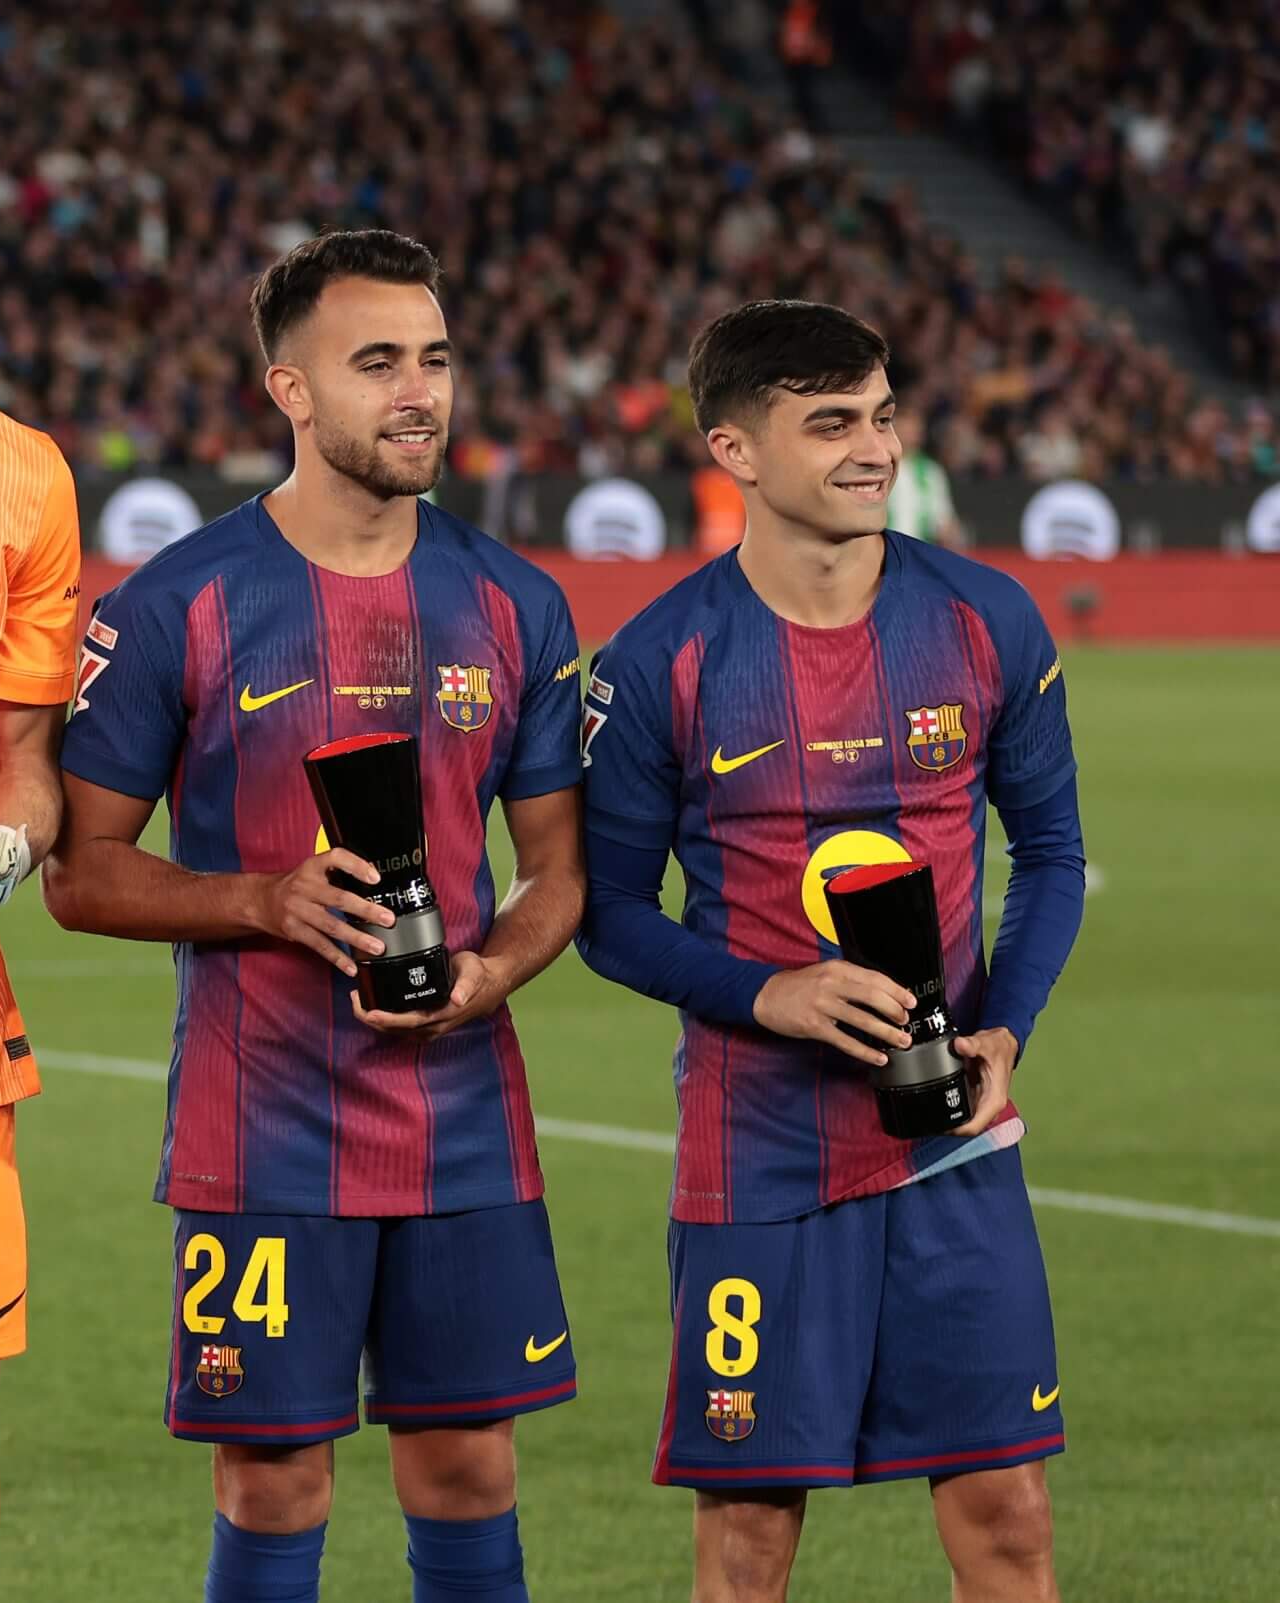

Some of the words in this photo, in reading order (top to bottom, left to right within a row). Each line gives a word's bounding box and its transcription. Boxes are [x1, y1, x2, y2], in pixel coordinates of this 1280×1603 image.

[455, 692, 477, 702] FCB
[926, 732, 949, 743] FCB
[183, 1232, 289, 1338] 24
[705, 1277, 762, 1378] 8
